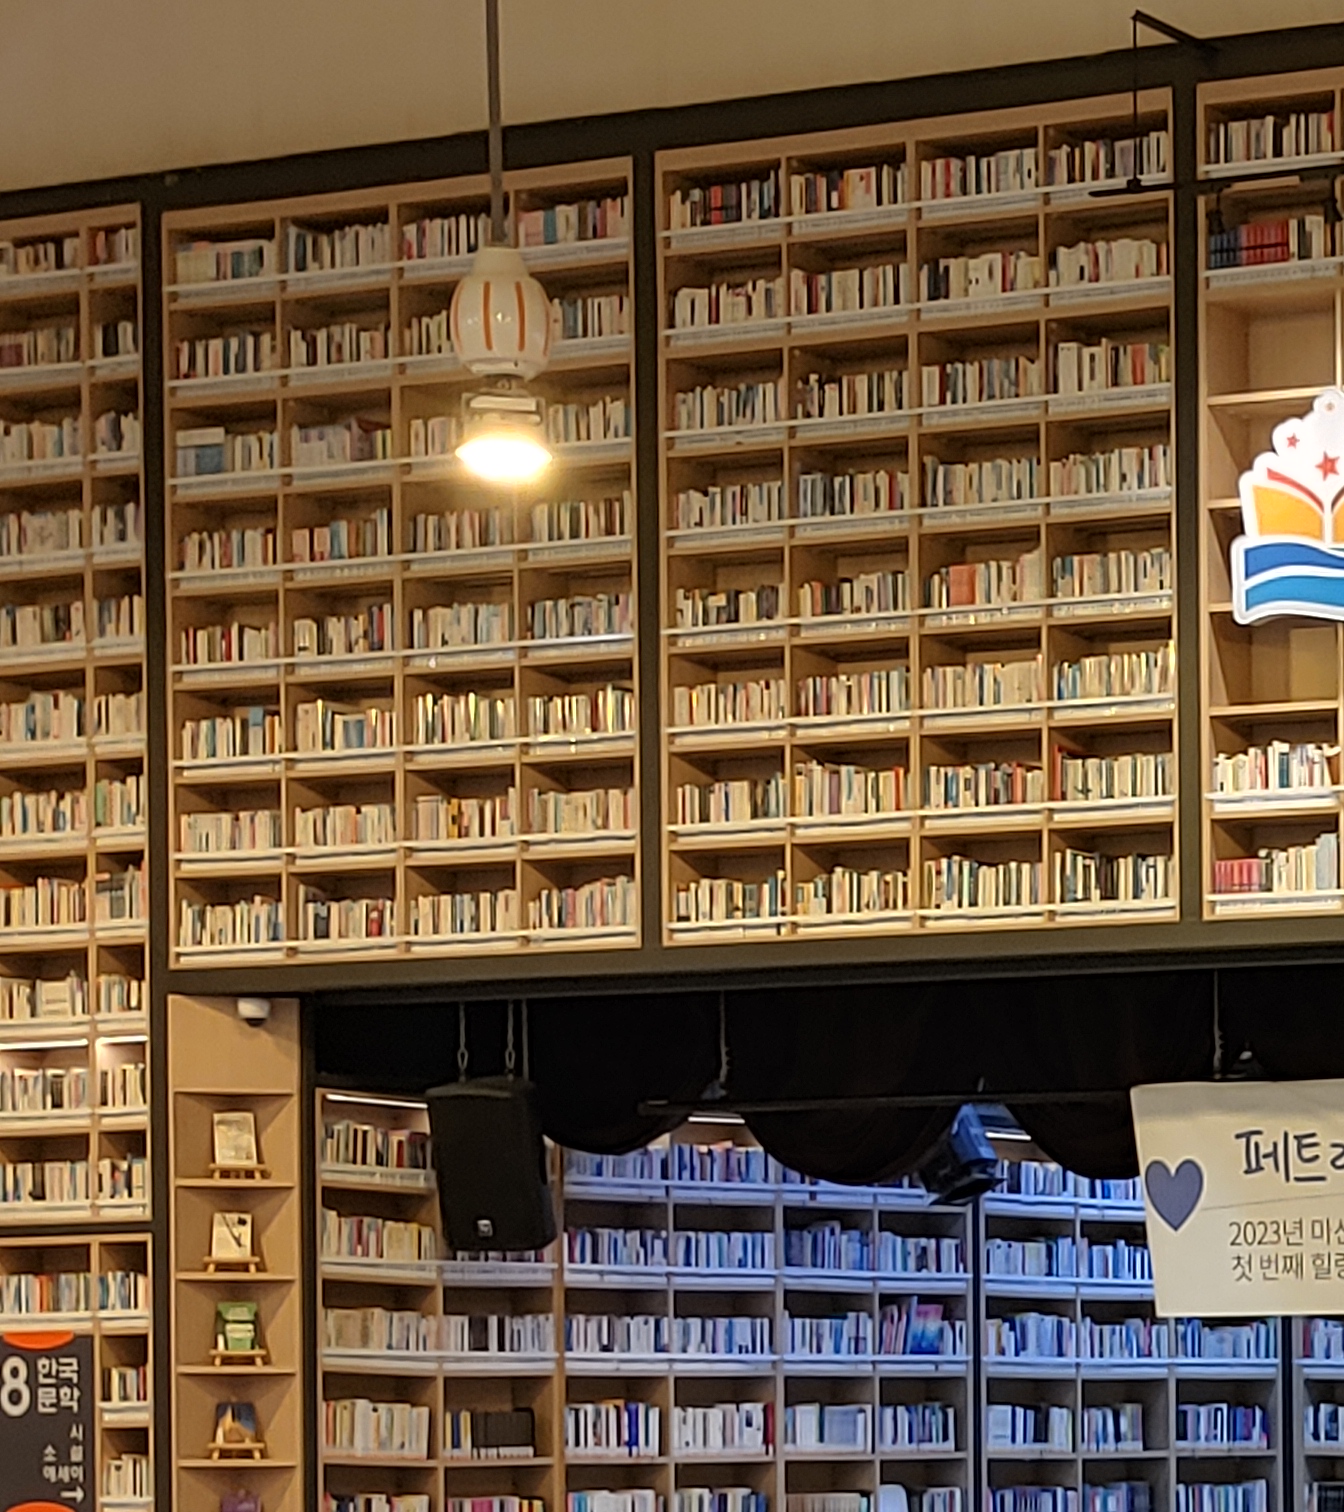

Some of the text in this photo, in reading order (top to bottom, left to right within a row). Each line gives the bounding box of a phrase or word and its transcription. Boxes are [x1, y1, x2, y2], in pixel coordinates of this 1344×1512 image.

[1229, 1216, 1304, 1247] 2023년
[1231, 1254, 1253, 1282] 첫
[1259, 1253, 1304, 1281] 번째
[36, 1356, 80, 1384] 한국
[0, 1356, 31, 1418] 8
[36, 1385, 82, 1414] 문학
